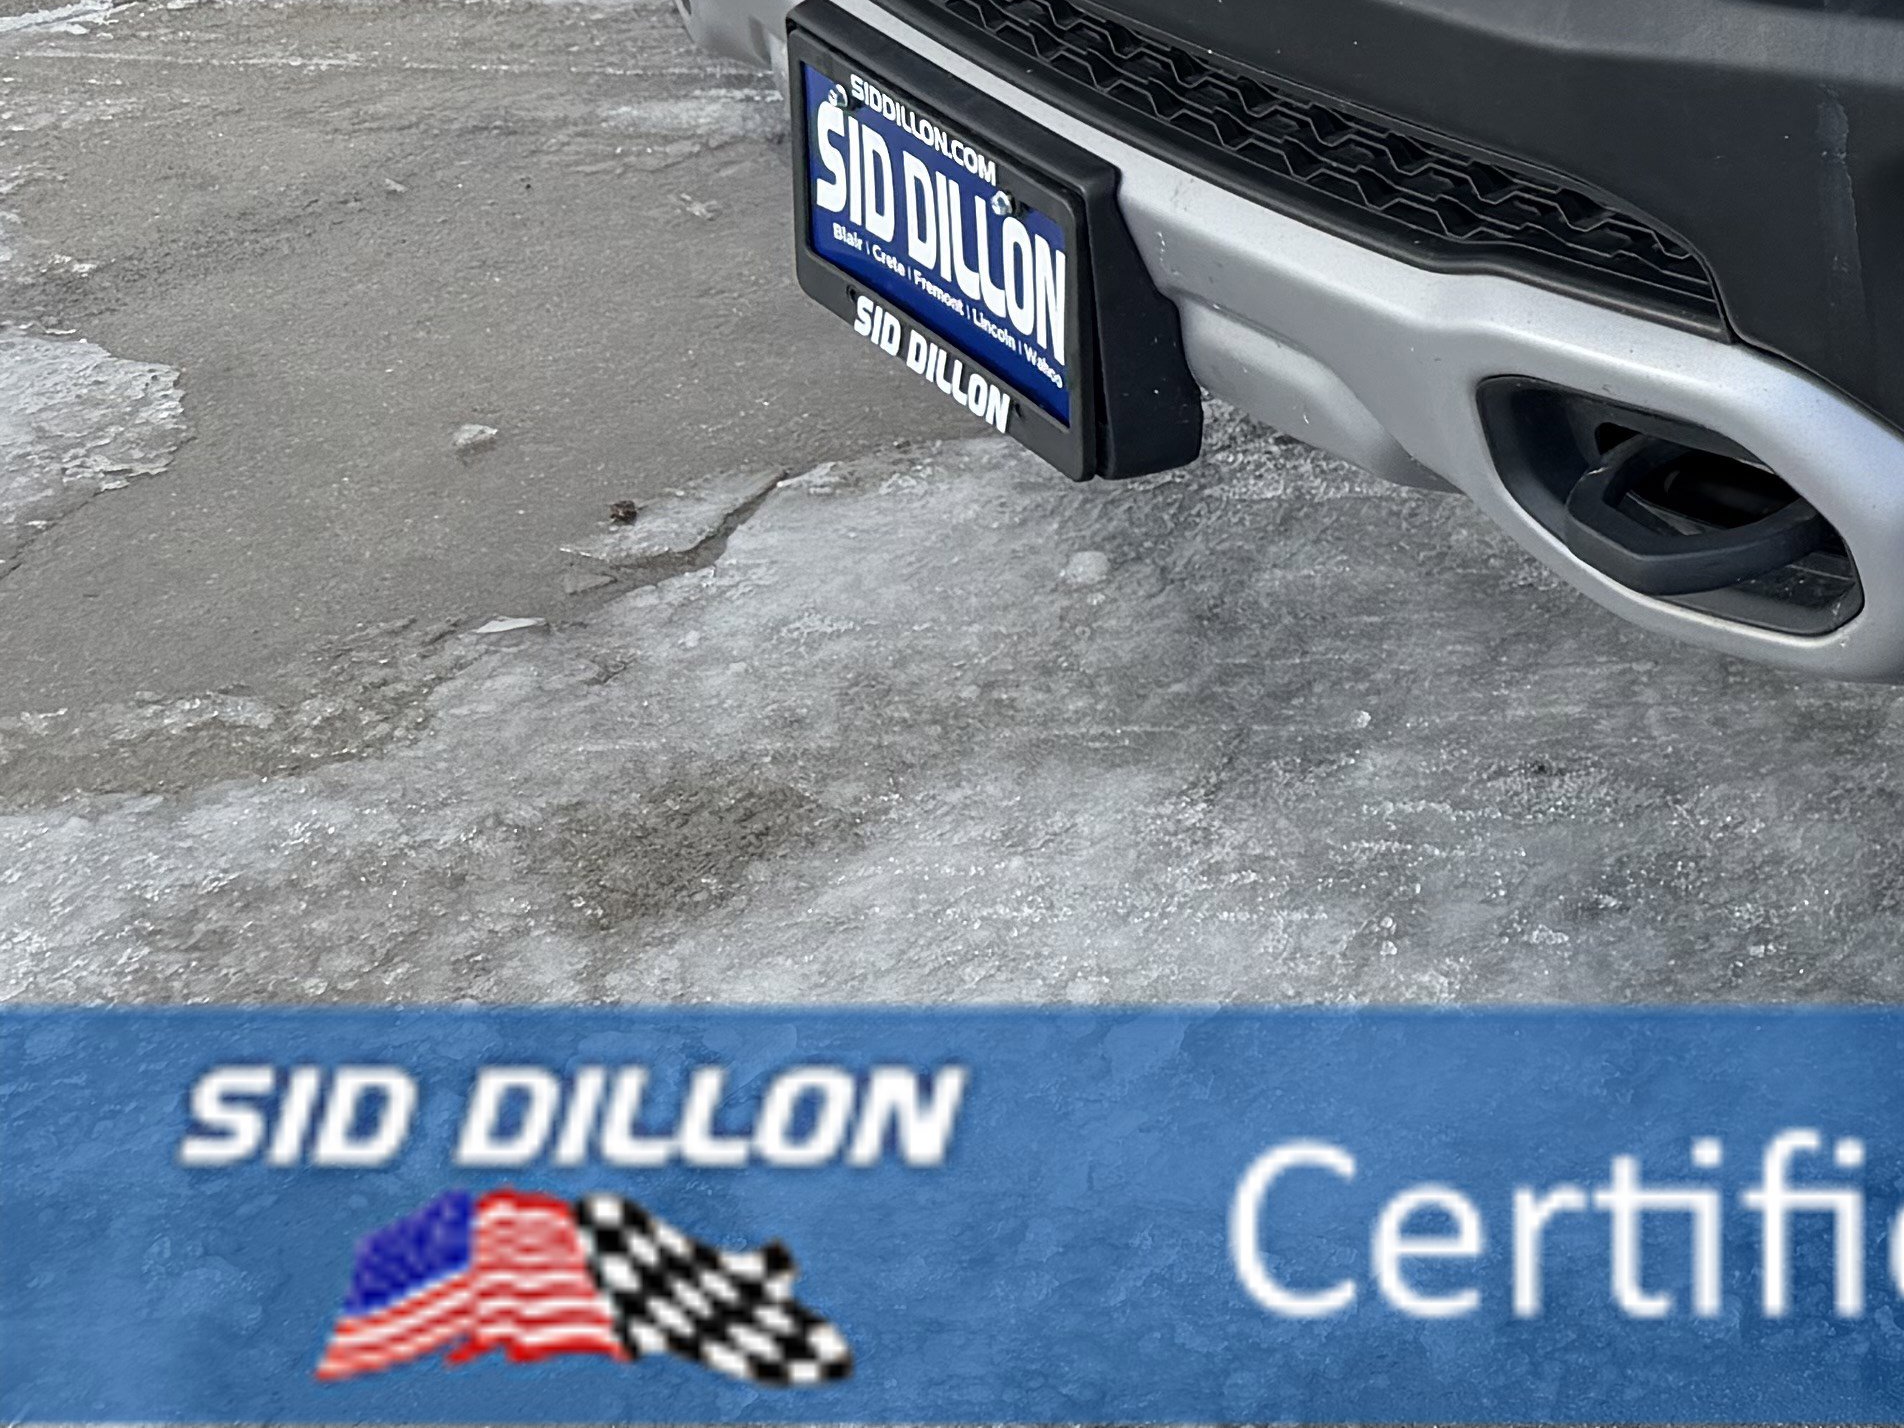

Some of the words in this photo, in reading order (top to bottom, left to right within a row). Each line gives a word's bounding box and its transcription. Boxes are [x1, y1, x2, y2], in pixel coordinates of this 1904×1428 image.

[850, 73, 997, 187] SIDDILLON.COM
[816, 100, 895, 243] SID
[902, 150, 1067, 366] DILLON
[832, 222, 863, 252] Blair
[871, 243, 906, 278] Crete
[914, 270, 964, 317] Fremont
[971, 307, 1017, 352] Lincoln
[853, 295, 902, 357] SID
[905, 329, 1011, 434] DILLON
